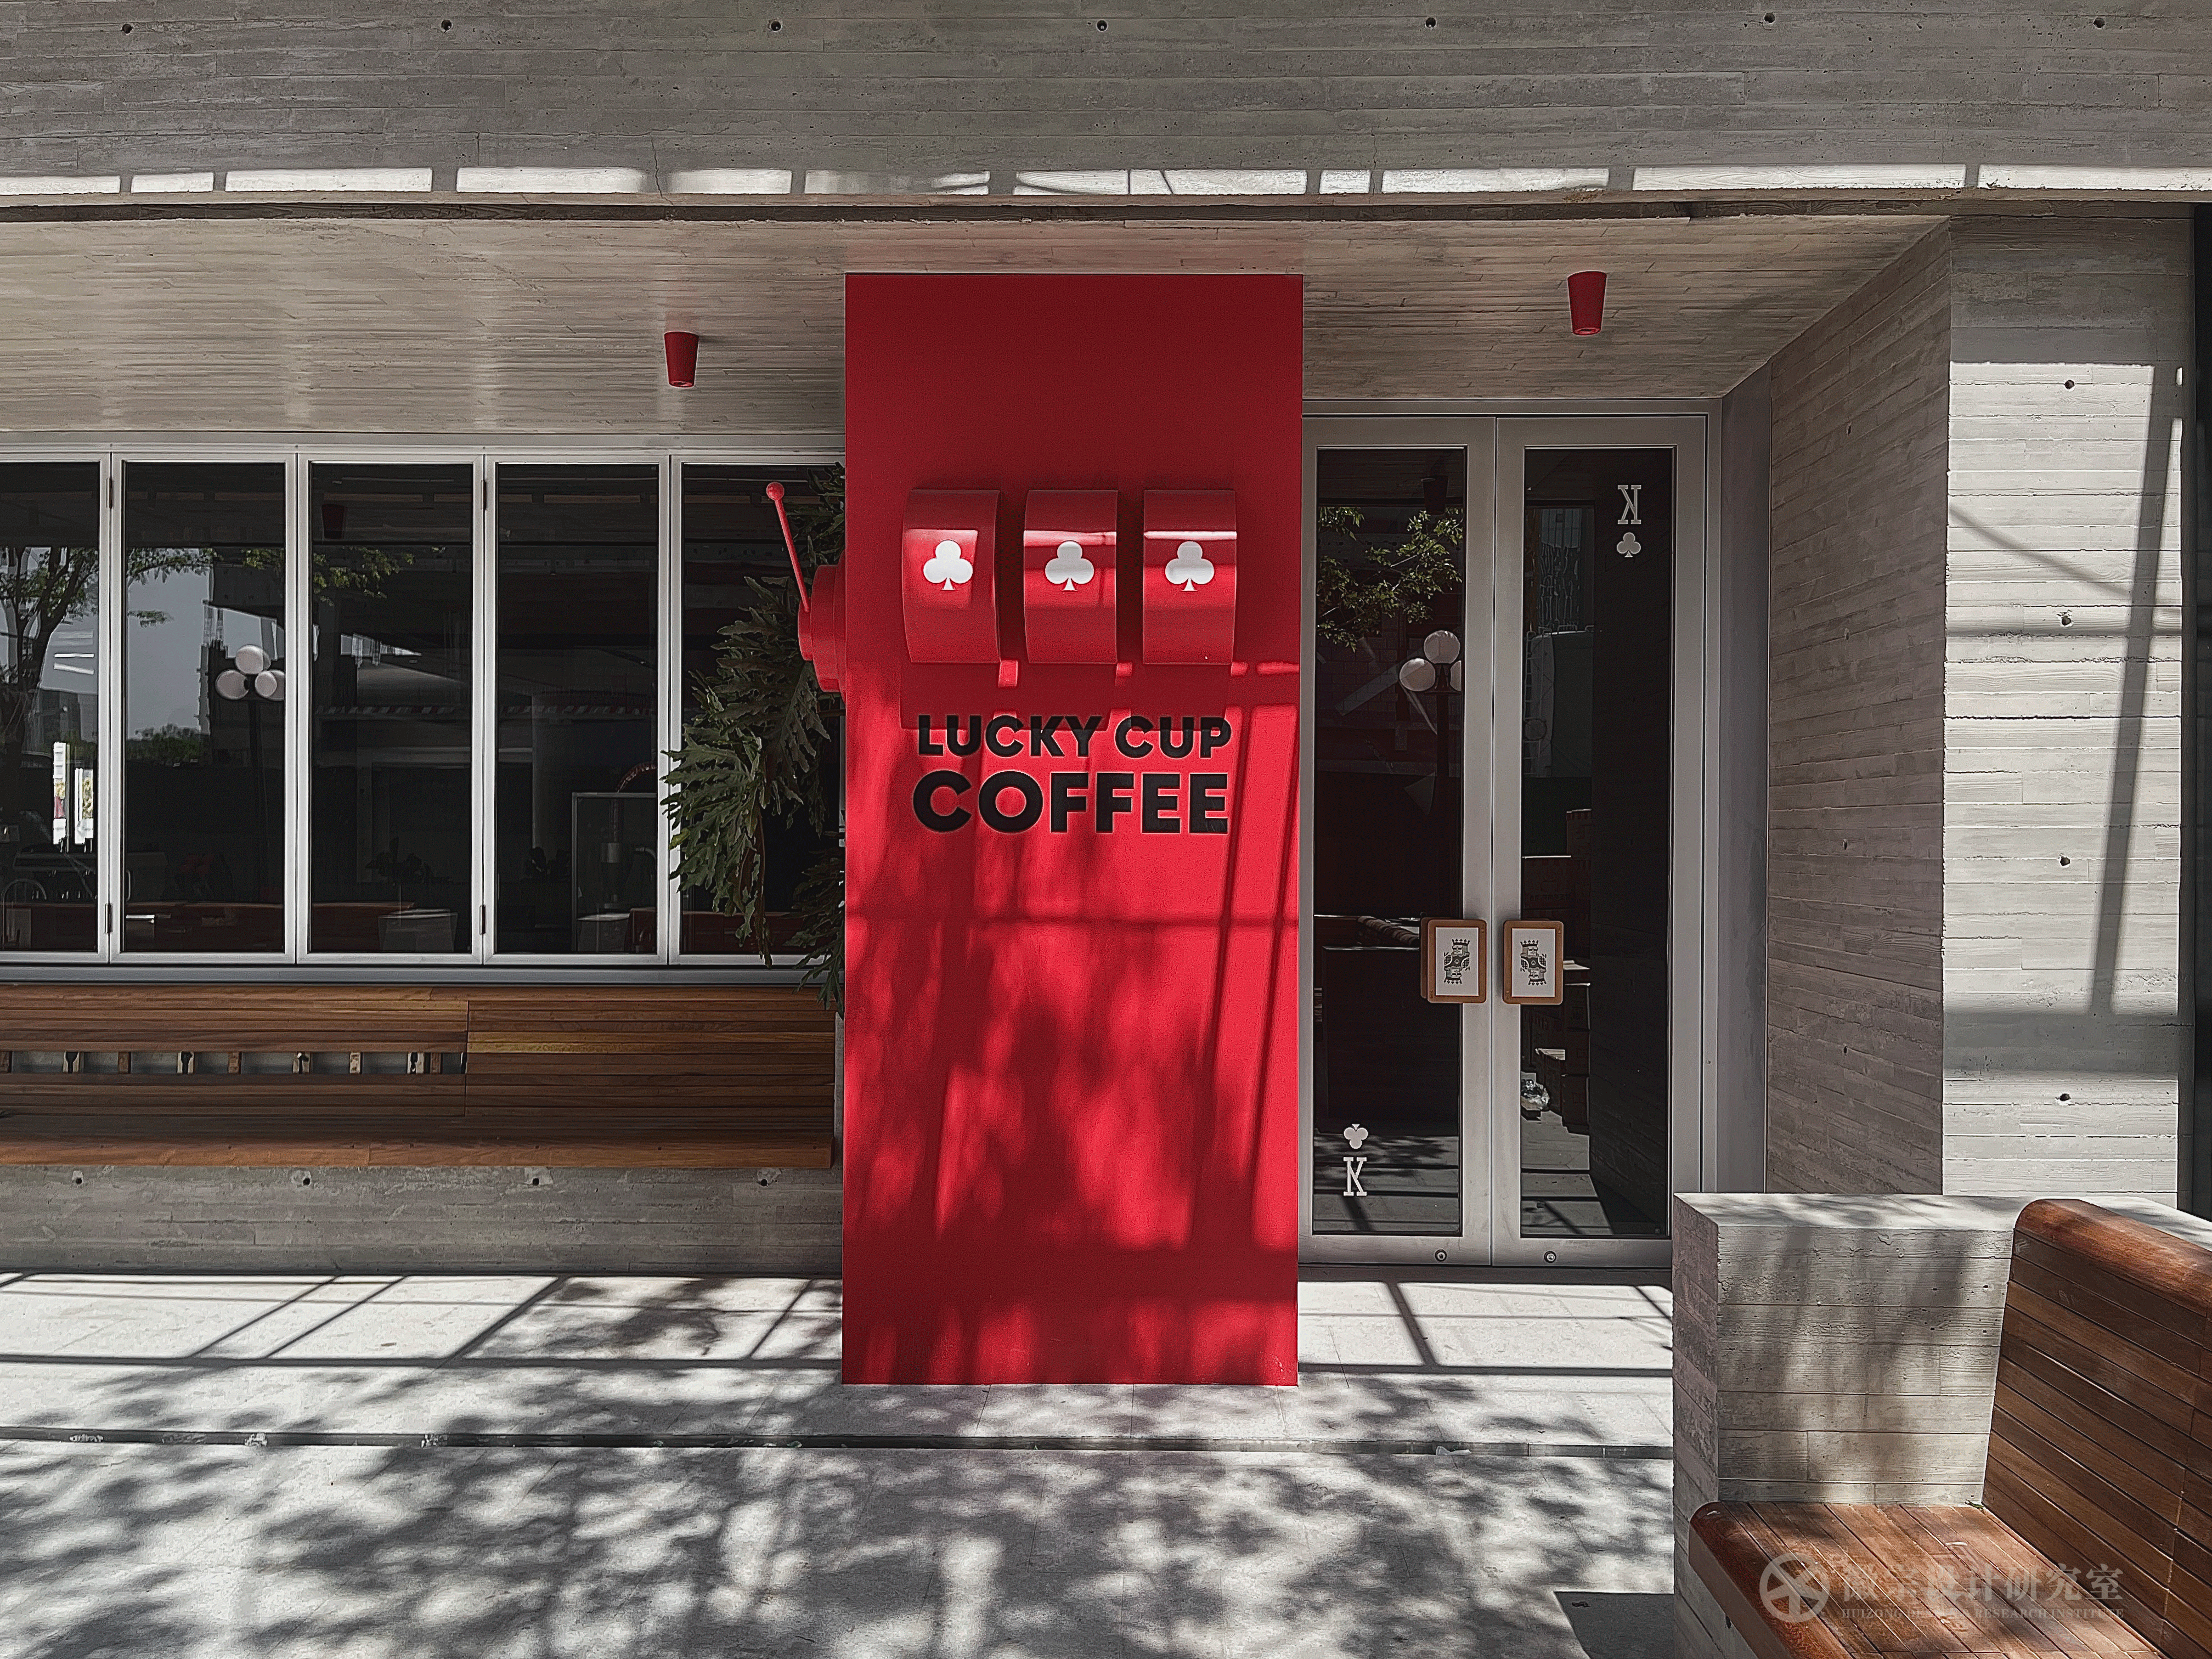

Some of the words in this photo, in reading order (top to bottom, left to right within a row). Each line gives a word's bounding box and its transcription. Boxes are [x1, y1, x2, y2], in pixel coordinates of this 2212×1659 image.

[1617, 484, 1641, 524] K
[918, 714, 1102, 758] LUCKY
[1114, 715, 1232, 759] CUP
[912, 769, 1229, 834] COFFEE
[1343, 1156, 1367, 1197] K
